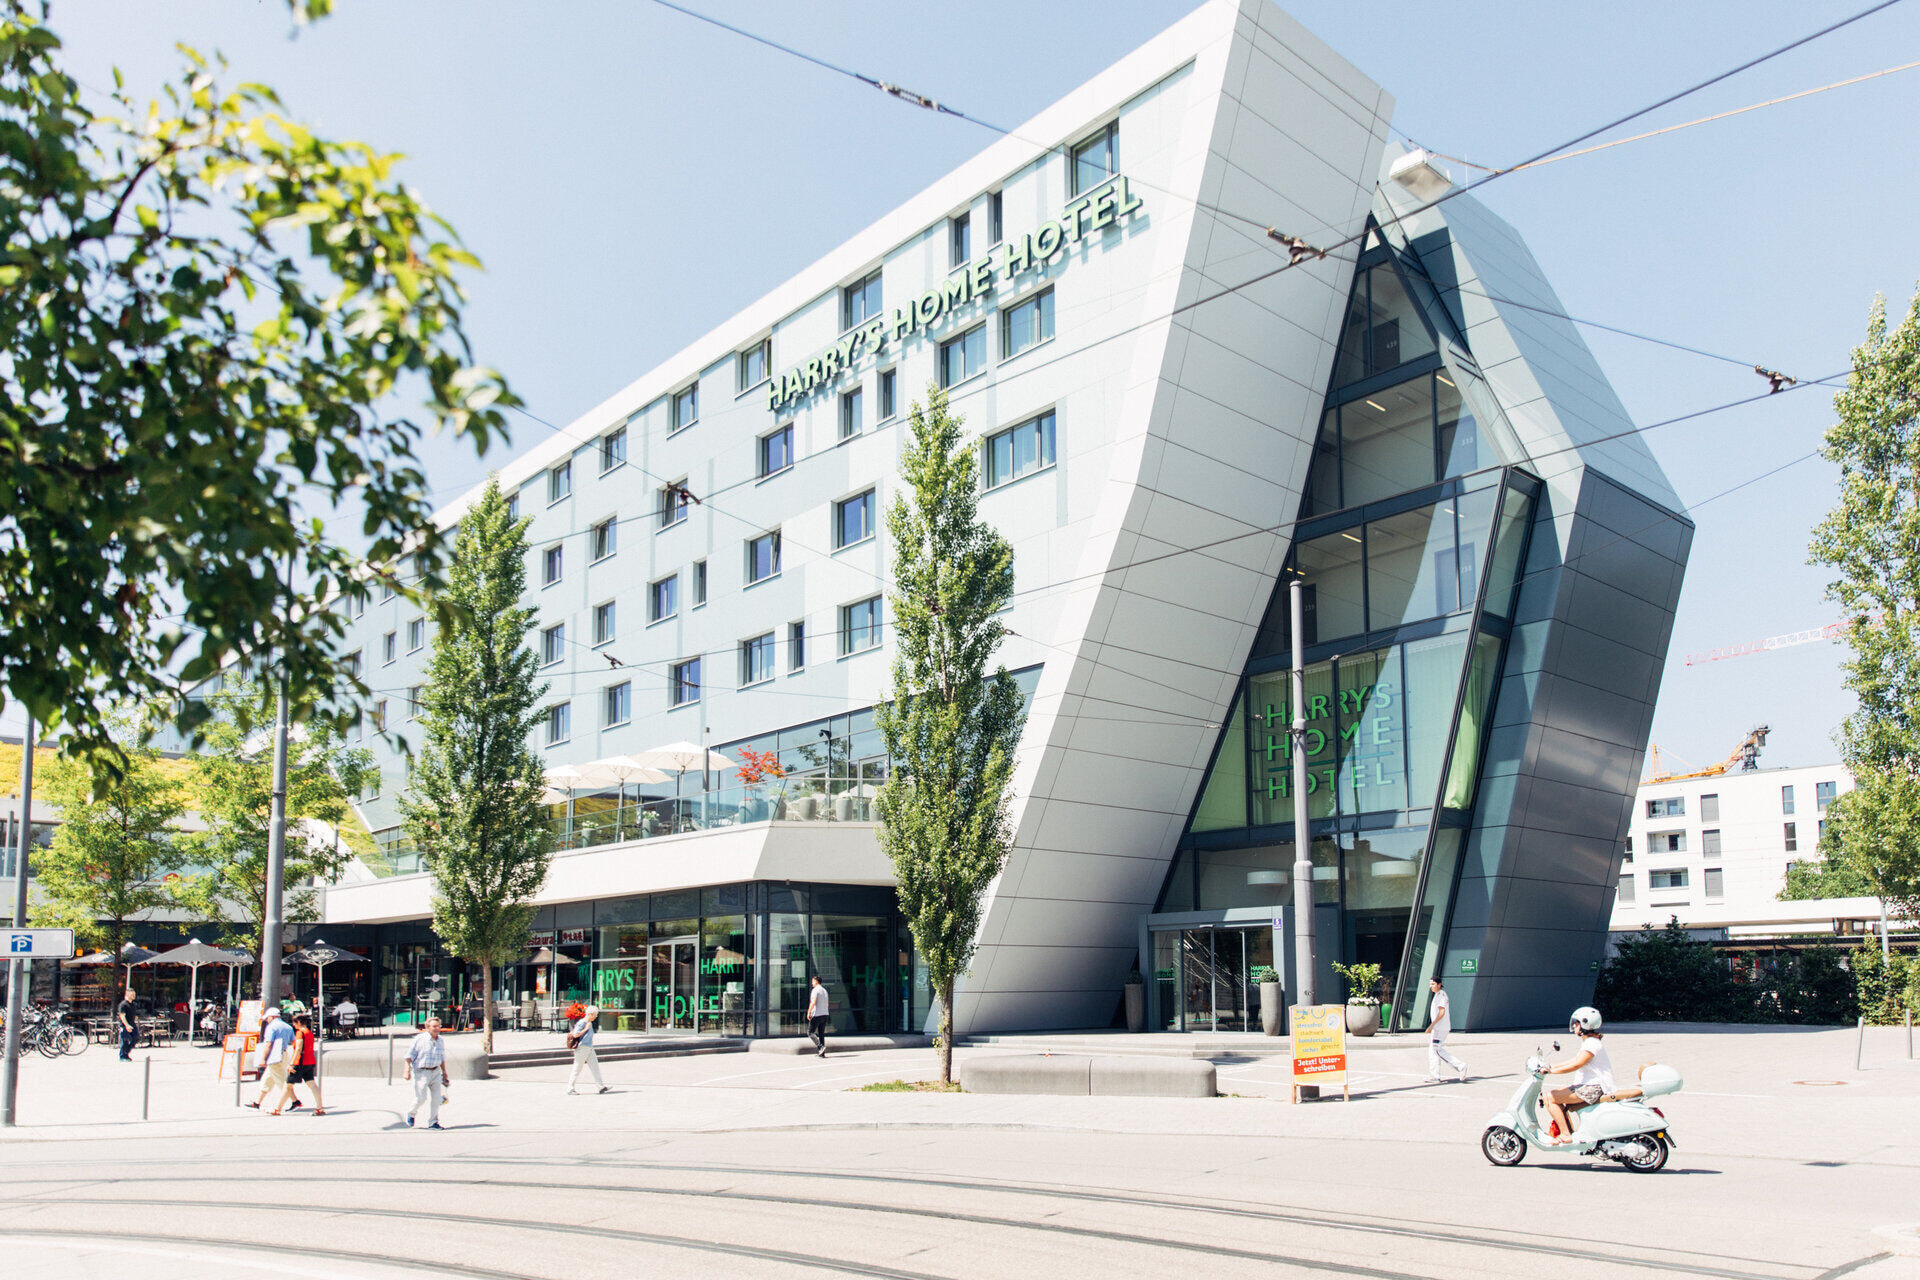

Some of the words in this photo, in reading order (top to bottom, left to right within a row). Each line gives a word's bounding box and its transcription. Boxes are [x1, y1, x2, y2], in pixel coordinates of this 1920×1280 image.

[767, 321, 883, 411] HARRY'S
[893, 256, 992, 341] HOME
[1004, 176, 1143, 280] HOTEL
[1297, 1058, 1317, 1067] Jetzt!
[1318, 1056, 1341, 1065] Unter-
[1303, 1063, 1336, 1073] schreiben
